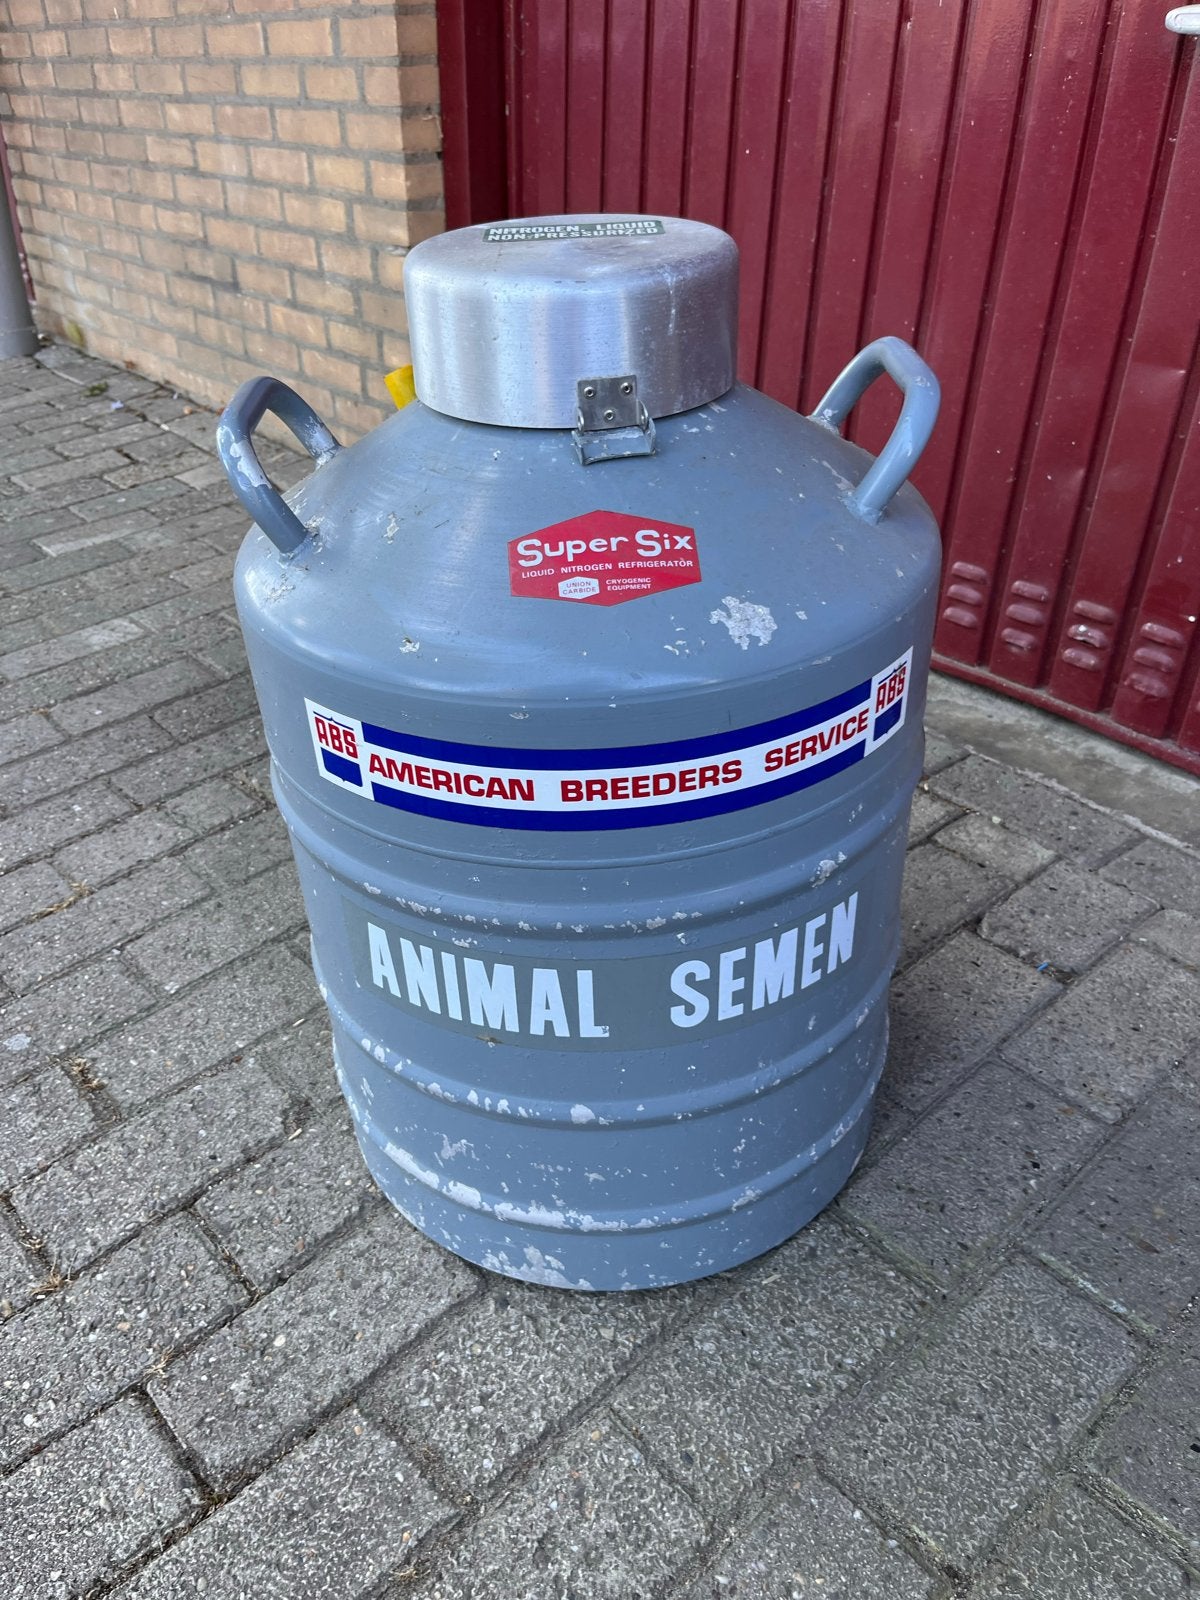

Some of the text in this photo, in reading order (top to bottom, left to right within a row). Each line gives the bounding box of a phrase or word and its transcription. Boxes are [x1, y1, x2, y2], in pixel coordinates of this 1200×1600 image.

[596, 220, 656, 231] LIQUID
[517, 529, 693, 567] Super Six
[521, 559, 693, 579] LIQUID NITROGEN REFRIGERATOR
[562, 586, 596, 595] CARBIDE
[566, 580, 592, 588] UNION
[605, 577, 651, 585] CRYOGENIC
[607, 583, 651, 591] EQUIPMENT
[875, 665, 905, 714] ABS
[314, 715, 358, 760] ABS
[368, 707, 870, 803] AMERICAN BREEDERS SERVICE
[367, 891, 859, 1038] ANIMAL SEMEN
